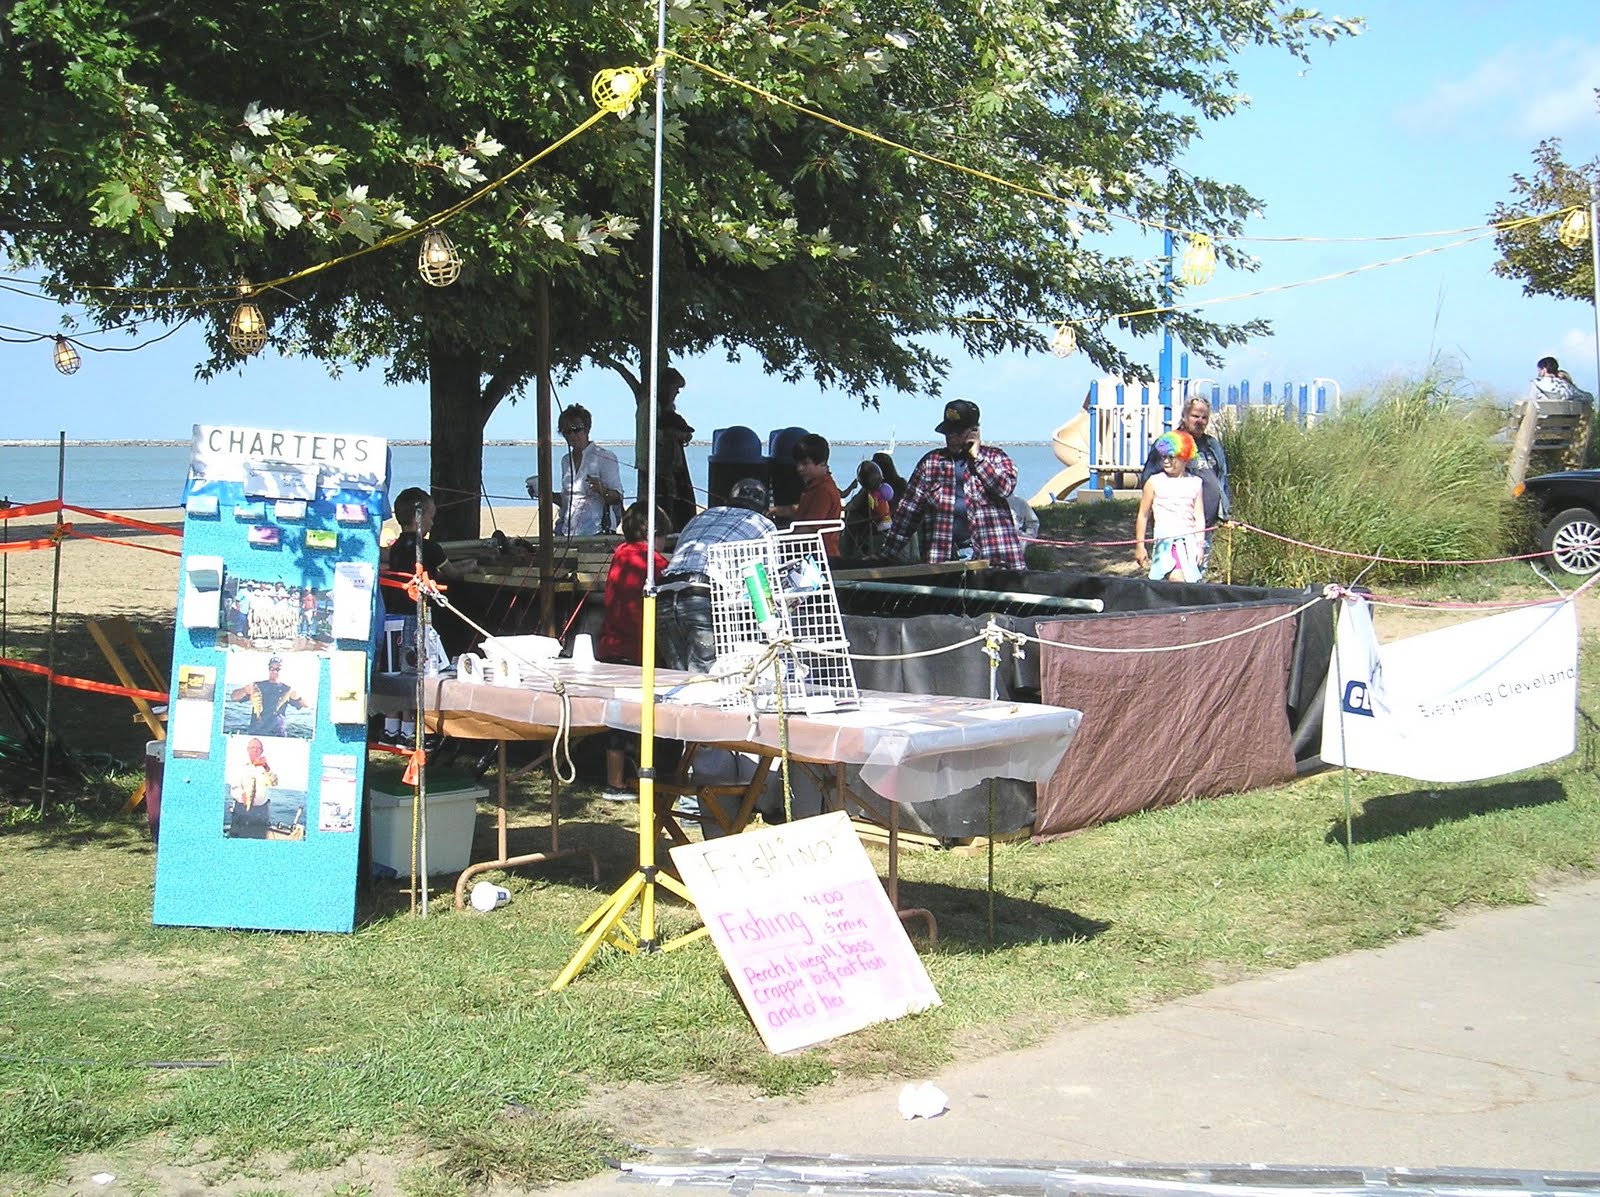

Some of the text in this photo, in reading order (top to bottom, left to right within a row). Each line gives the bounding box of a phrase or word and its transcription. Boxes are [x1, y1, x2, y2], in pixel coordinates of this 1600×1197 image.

[208, 429, 369, 462] CHARTERS
[714, 906, 814, 945] Fishing
[767, 991, 846, 1028] and oher
